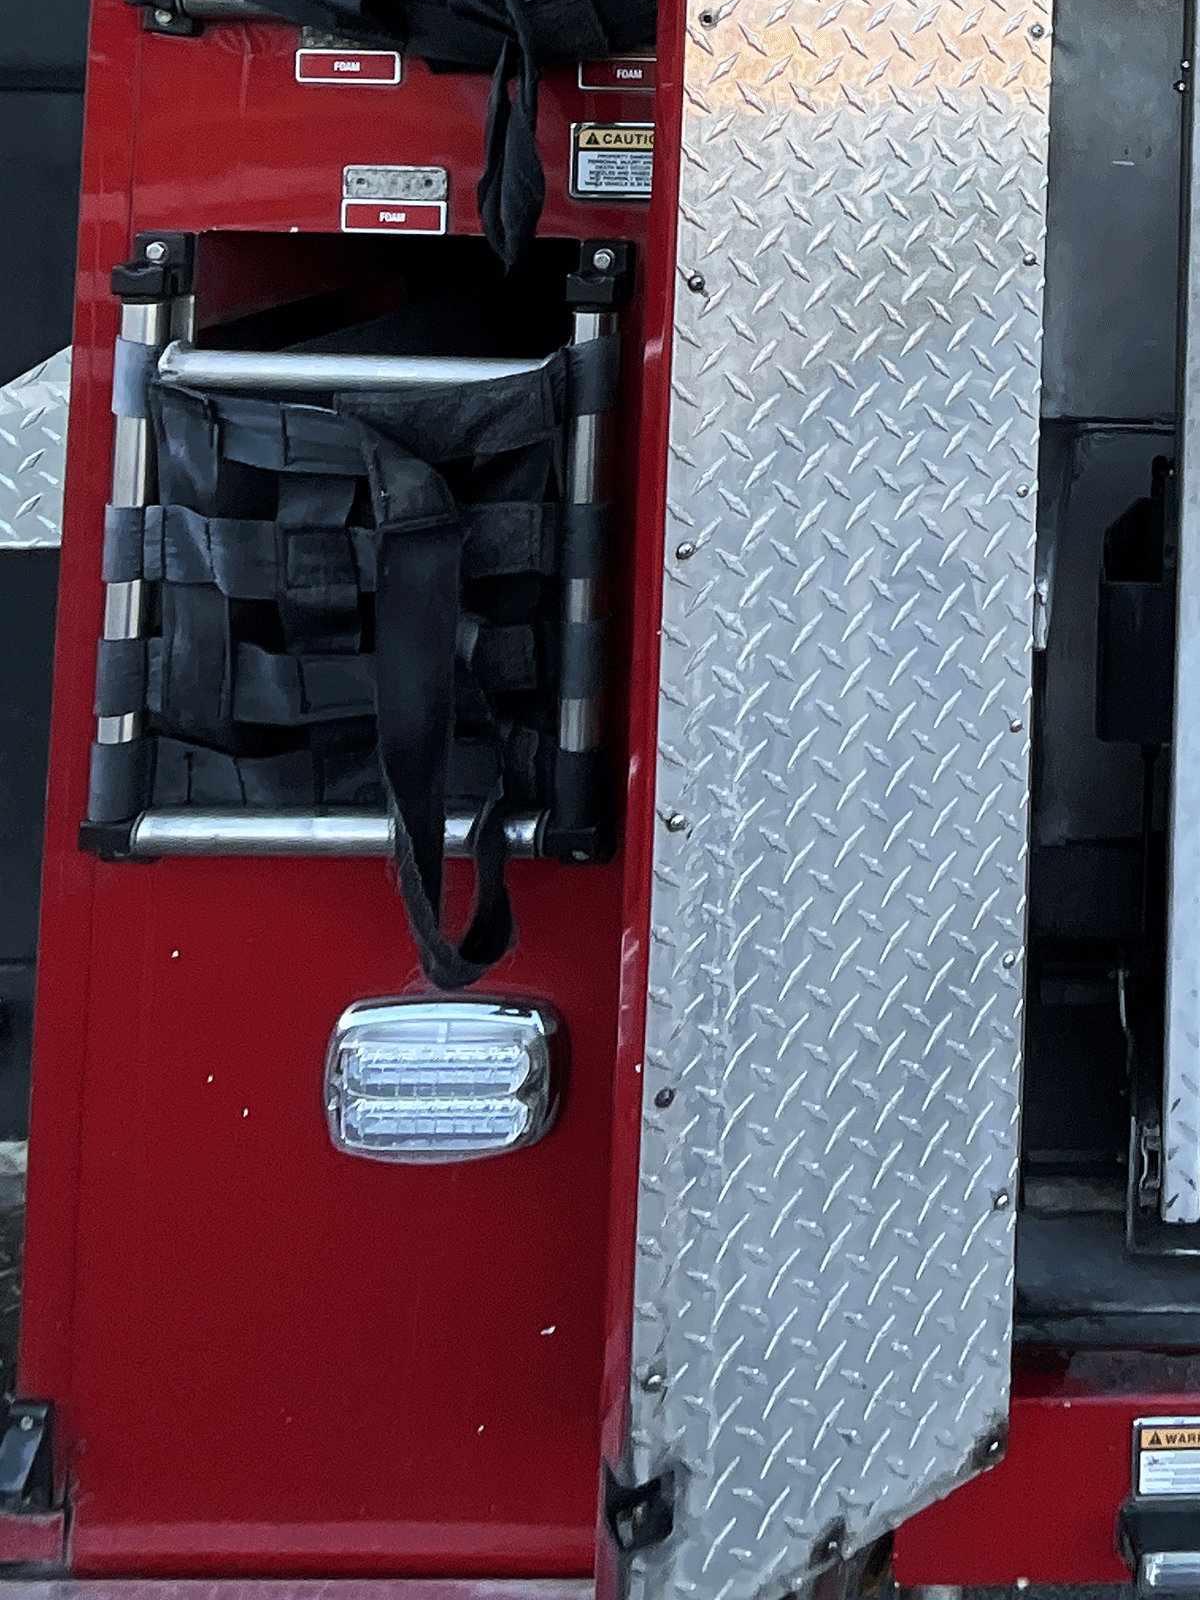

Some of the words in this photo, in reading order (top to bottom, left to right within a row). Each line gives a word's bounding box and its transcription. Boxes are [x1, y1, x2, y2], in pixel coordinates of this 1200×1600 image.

[333, 61, 361, 72] FOAM
[616, 68, 643, 79] FOAM
[379, 211, 406, 223] FOAM
